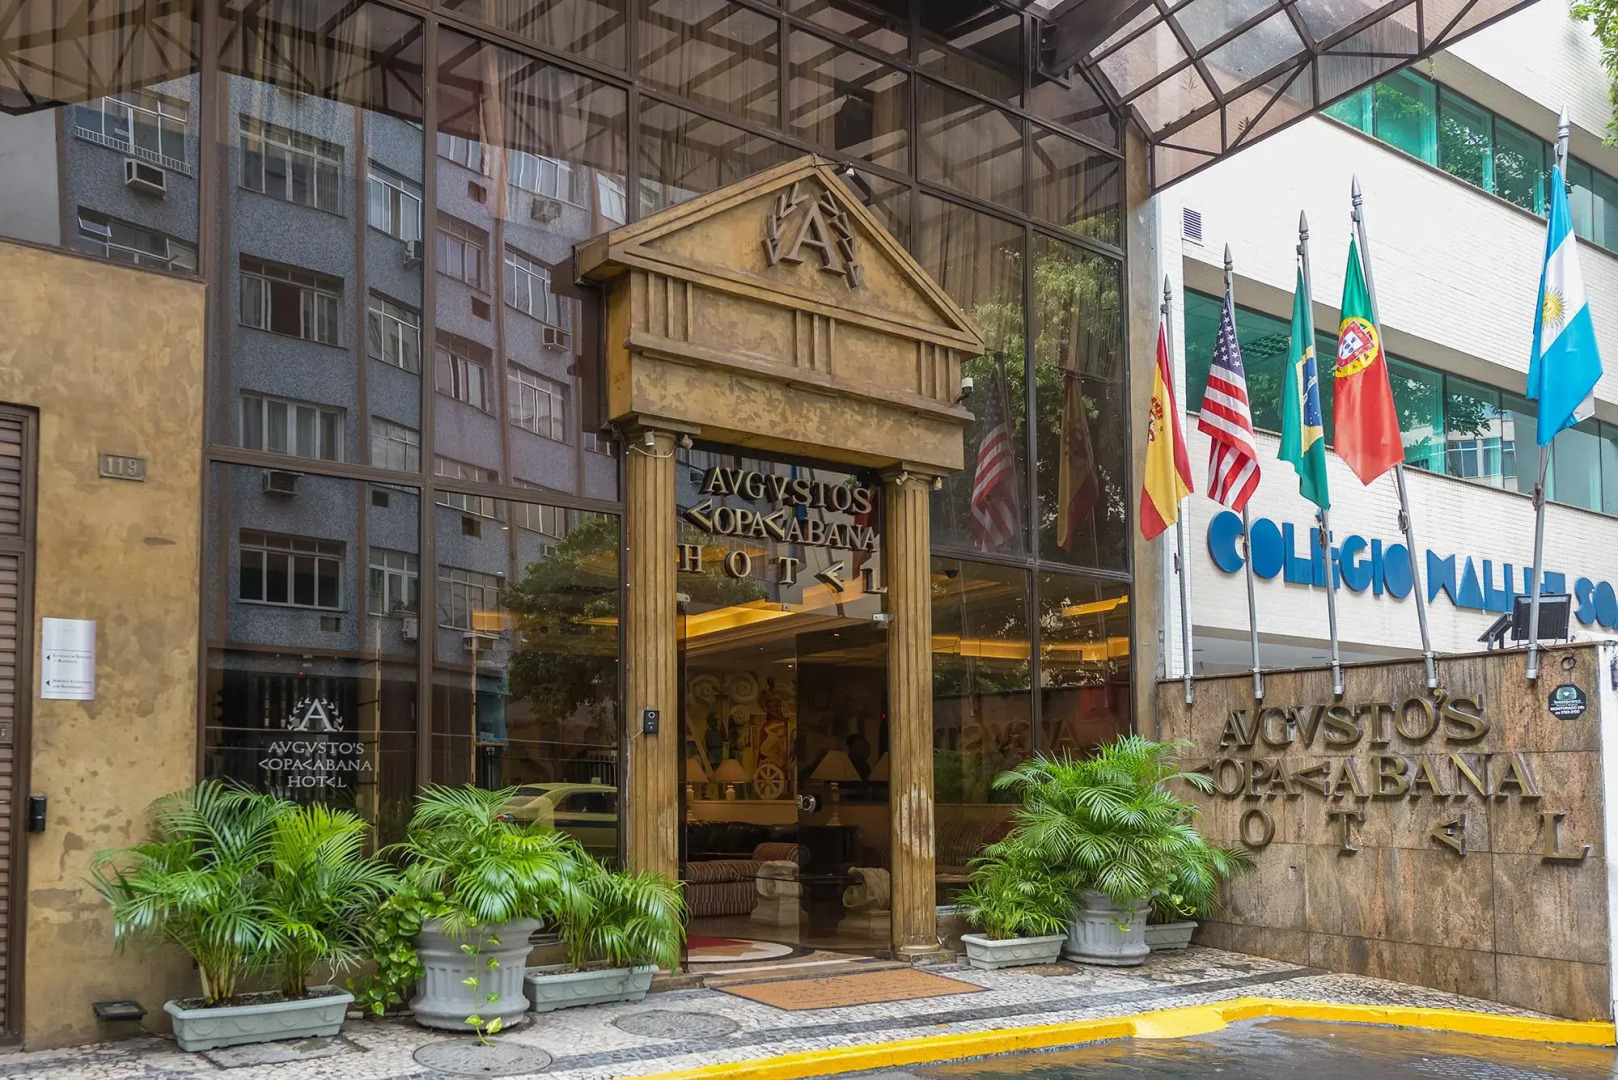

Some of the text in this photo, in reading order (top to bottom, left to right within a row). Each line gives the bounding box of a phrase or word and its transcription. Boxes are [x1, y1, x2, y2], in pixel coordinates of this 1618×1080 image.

[106, 457, 137, 476] 119
[1574, 577, 1618, 629] SO
[1239, 807, 1590, 862] OTEL
